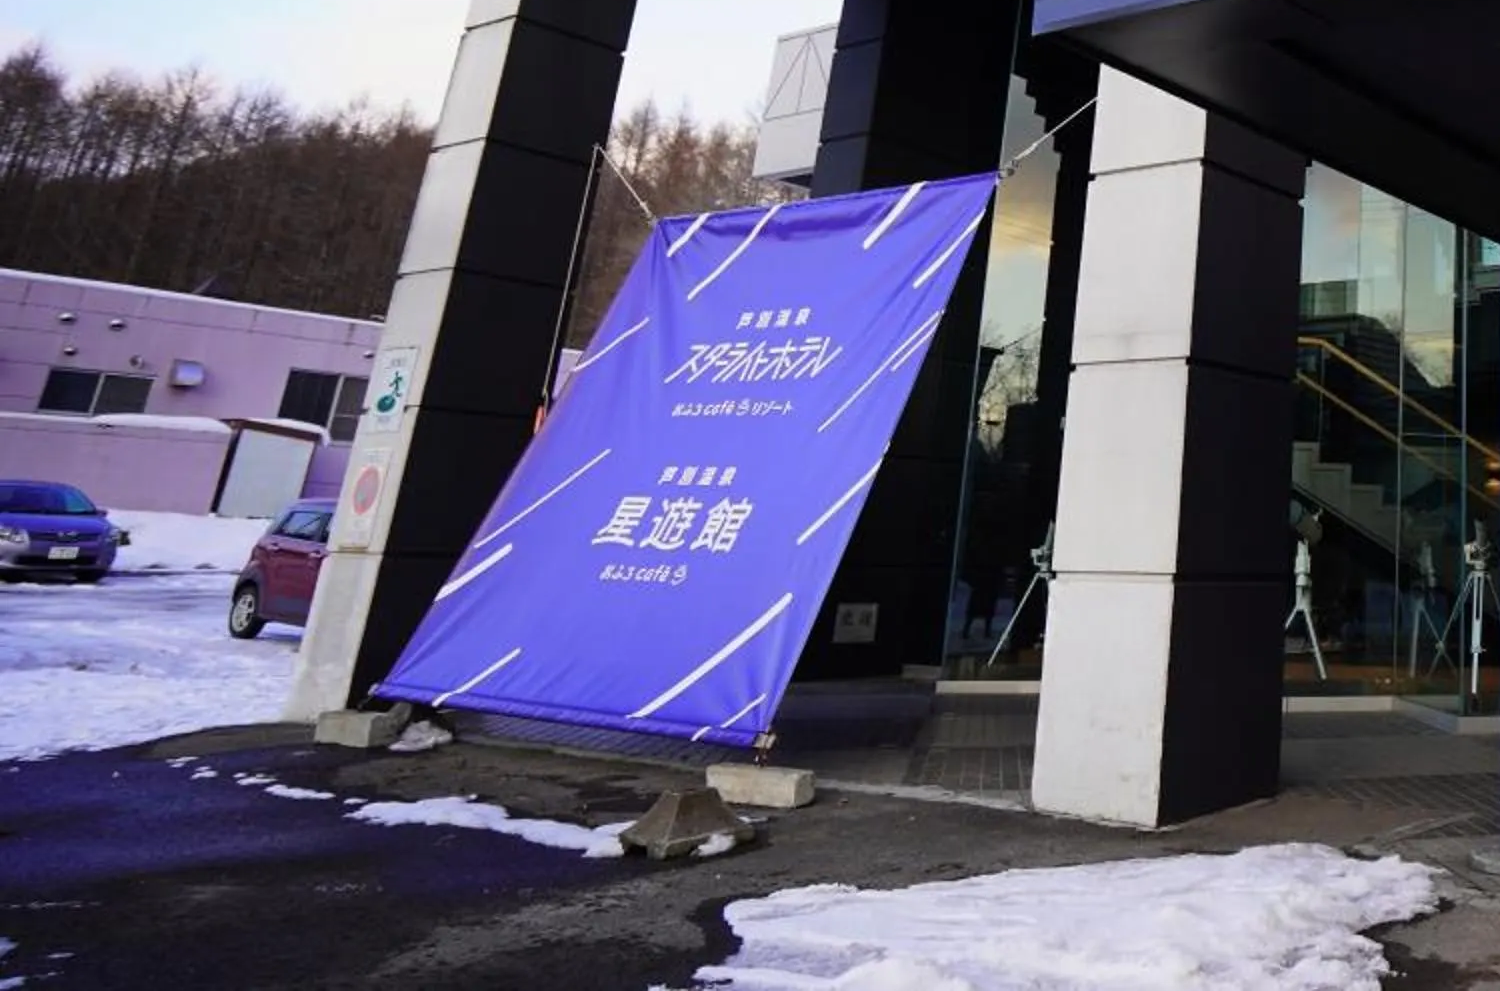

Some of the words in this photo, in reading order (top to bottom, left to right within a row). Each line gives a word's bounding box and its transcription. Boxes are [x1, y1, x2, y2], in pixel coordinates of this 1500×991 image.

[663, 336, 844, 384] スターライトホテル
[592, 495, 753, 553] 星遊館
